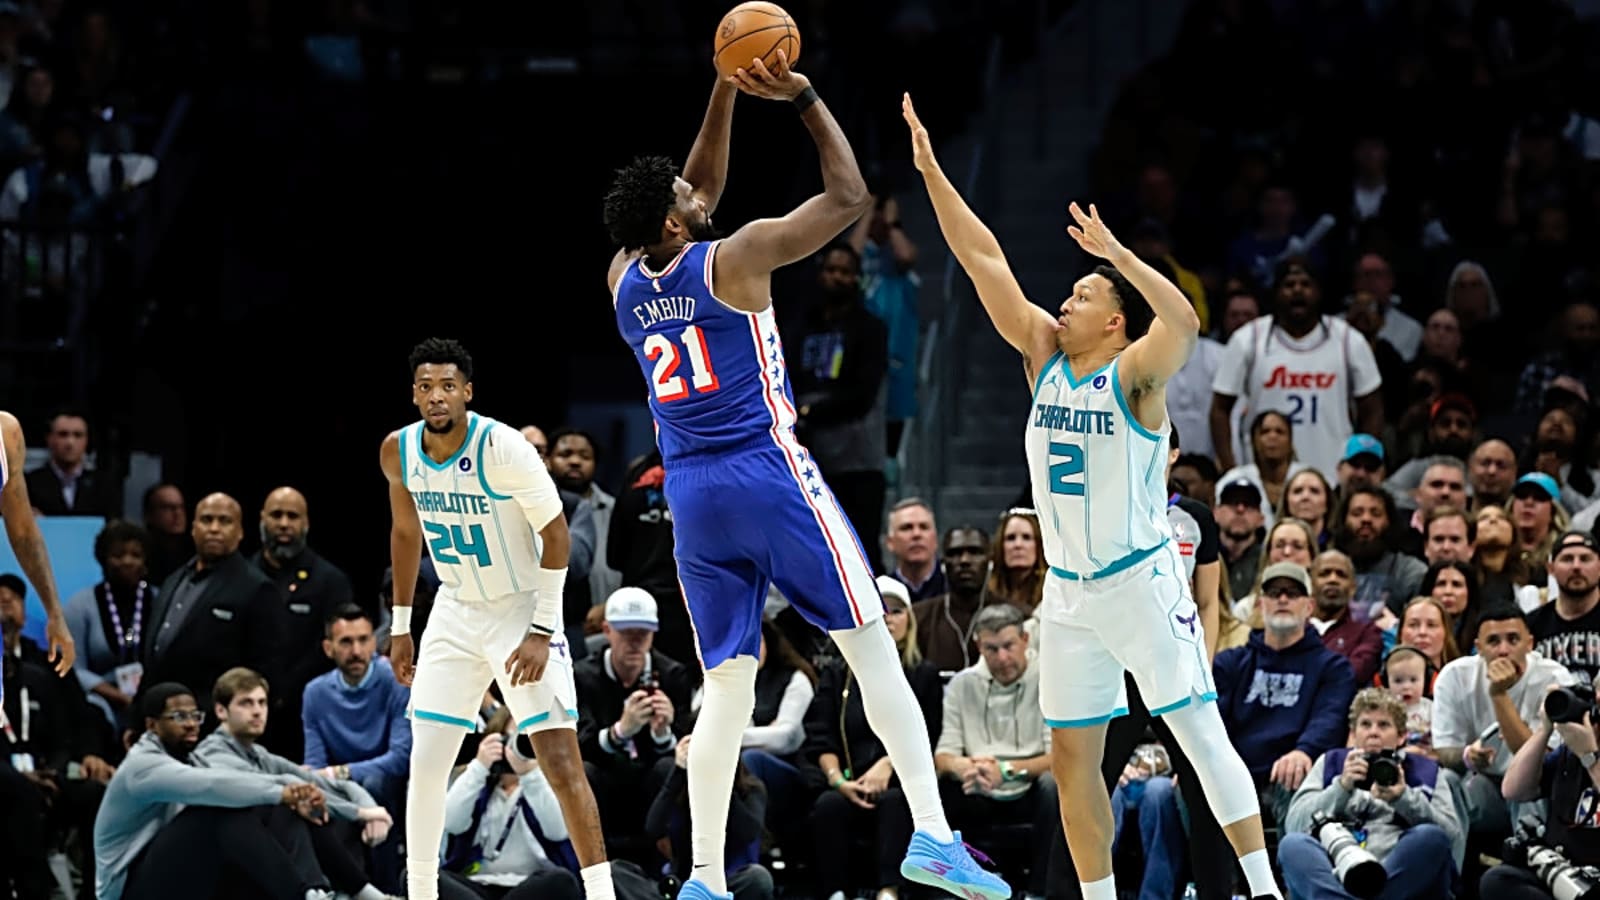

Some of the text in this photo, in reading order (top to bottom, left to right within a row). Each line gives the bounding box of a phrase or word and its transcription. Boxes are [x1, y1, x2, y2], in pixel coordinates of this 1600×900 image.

[633, 297, 696, 329] EMBIID
[643, 325, 720, 404] 21
[1034, 403, 1115, 436] CHARLOTTE
[1286, 394, 1318, 425] 21
[1049, 441, 1085, 497] 2
[422, 519, 493, 567] 24
